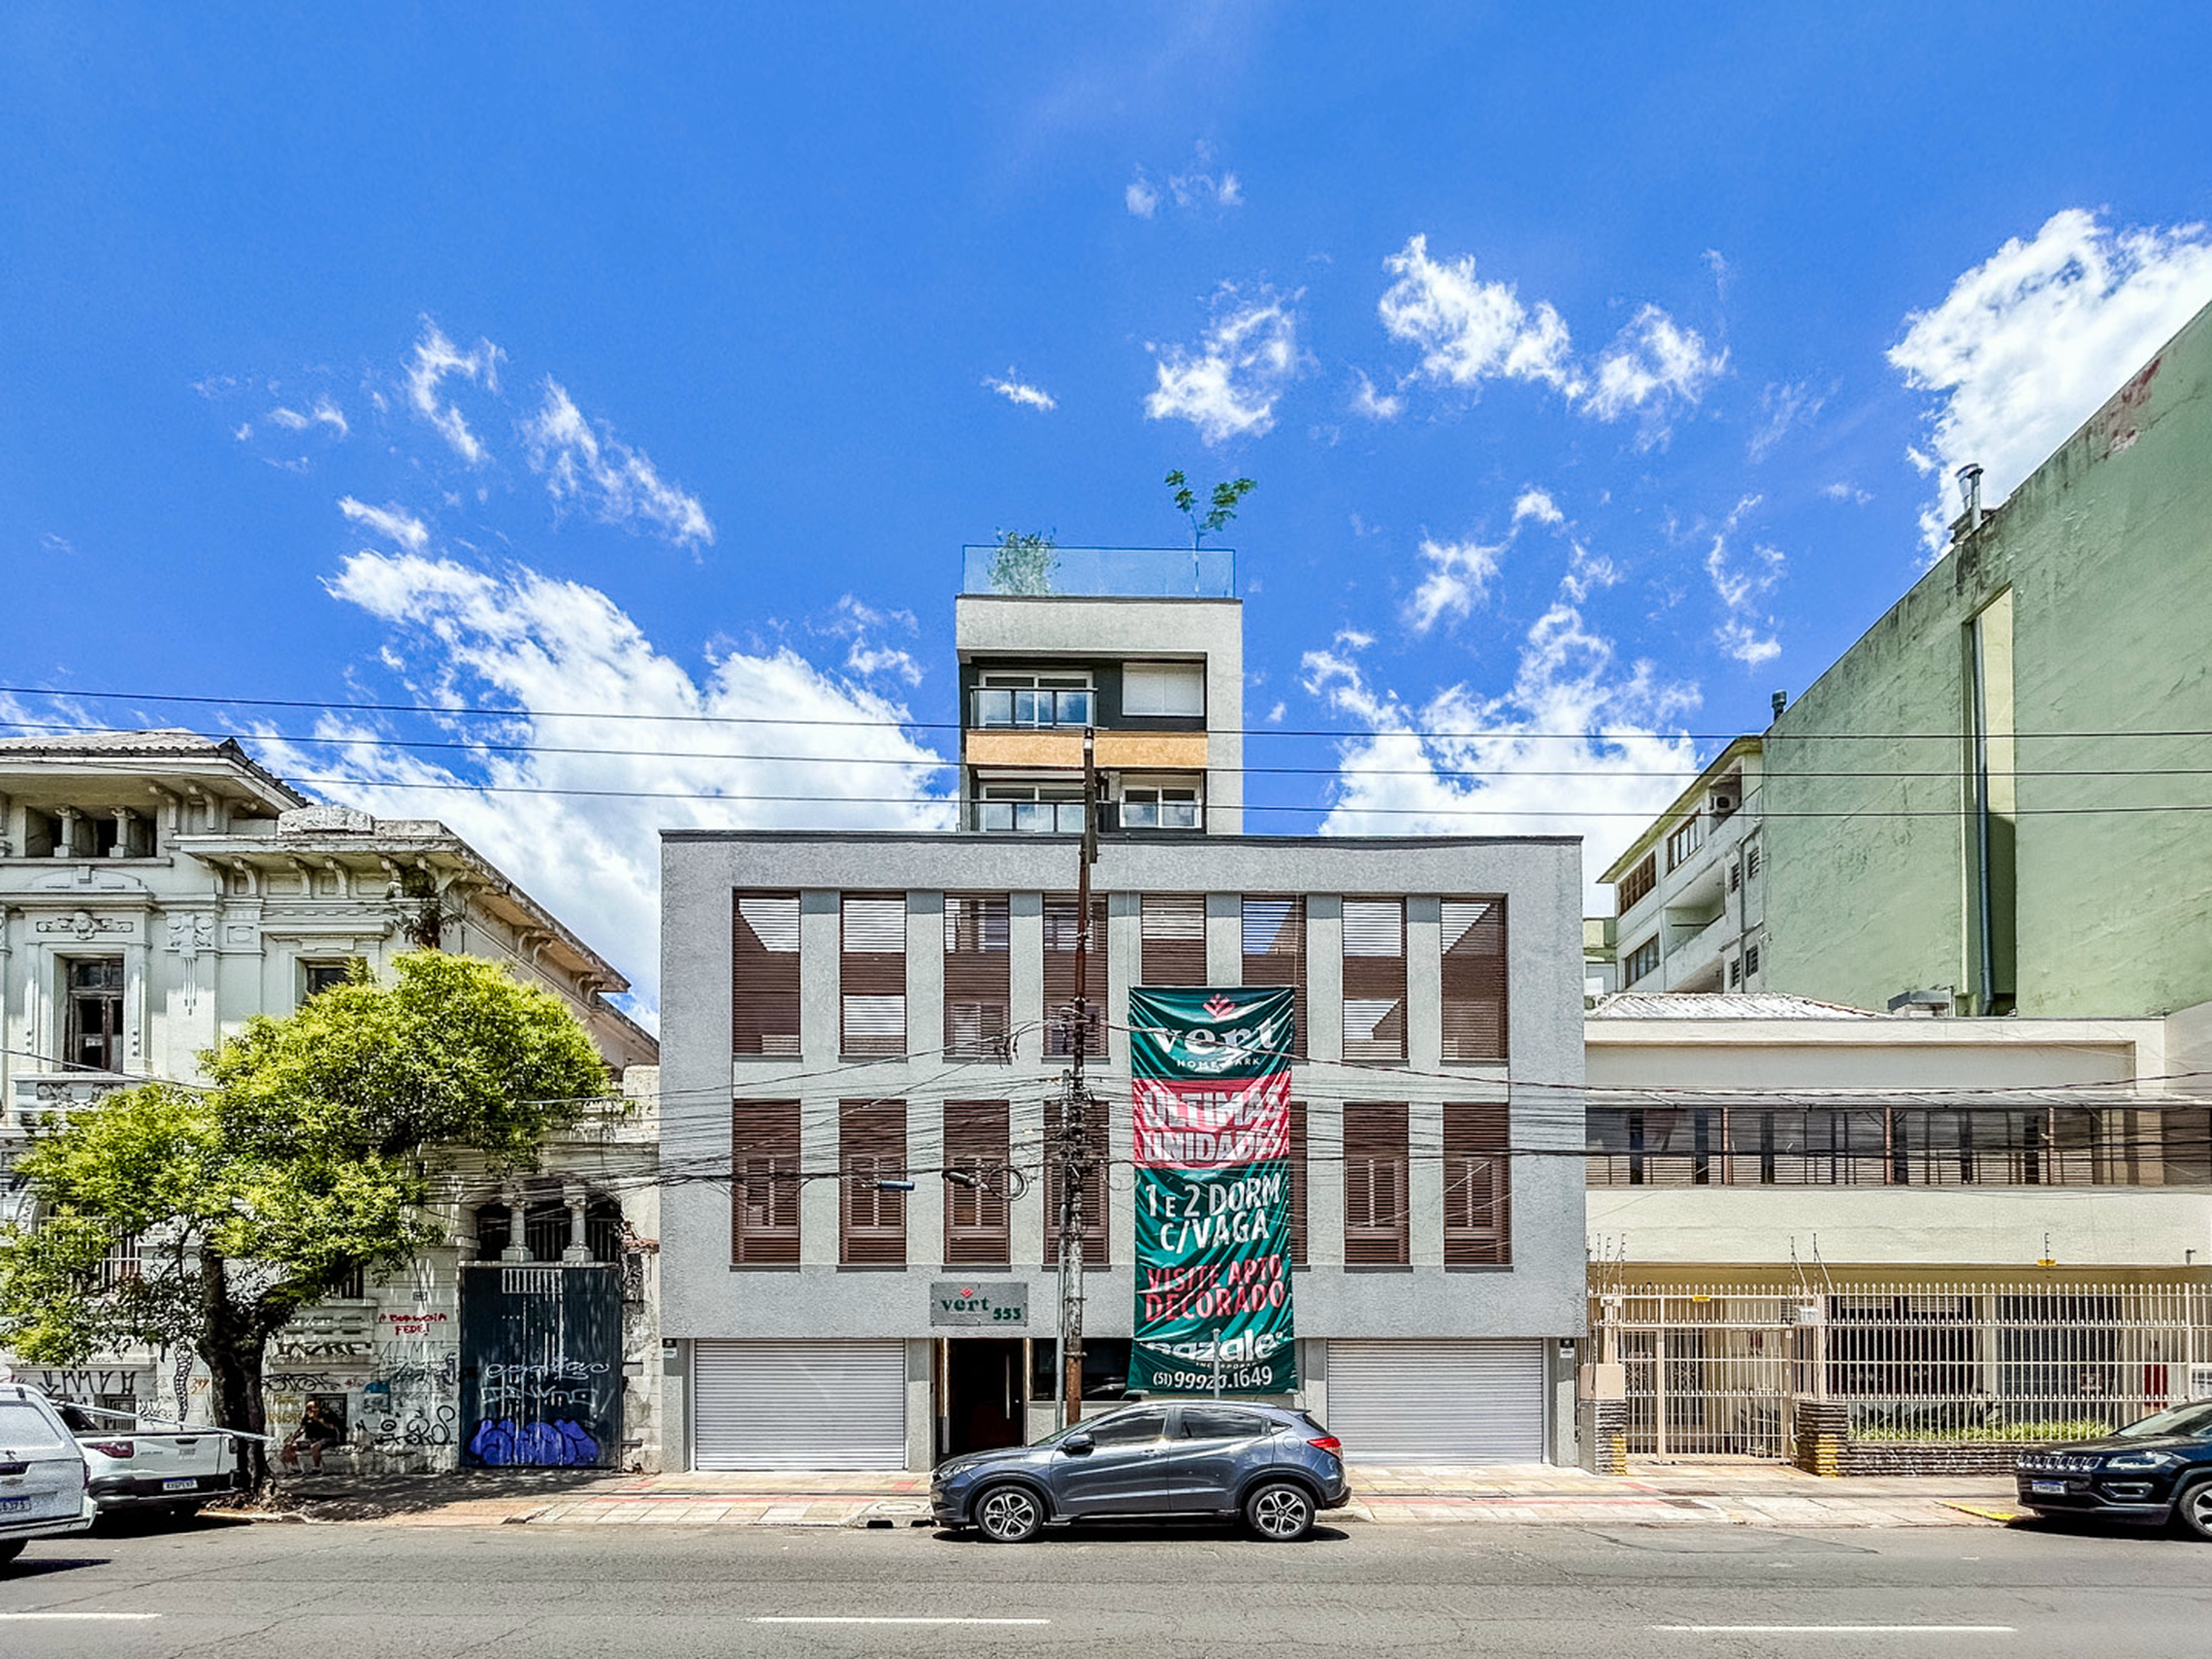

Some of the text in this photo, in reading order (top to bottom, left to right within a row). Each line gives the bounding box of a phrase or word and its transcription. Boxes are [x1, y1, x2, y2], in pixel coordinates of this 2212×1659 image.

[1145, 1184, 1157, 1217] 1
[1184, 1184, 1201, 1218] 2
[1209, 1172, 1281, 1216] DORM
[1159, 1208, 1270, 1253] C/VAGA
[1146, 1253, 1283, 1292] VISITE APTO
[941, 1297, 990, 1312] vert
[1145, 1280, 1285, 1322] DECORADO
